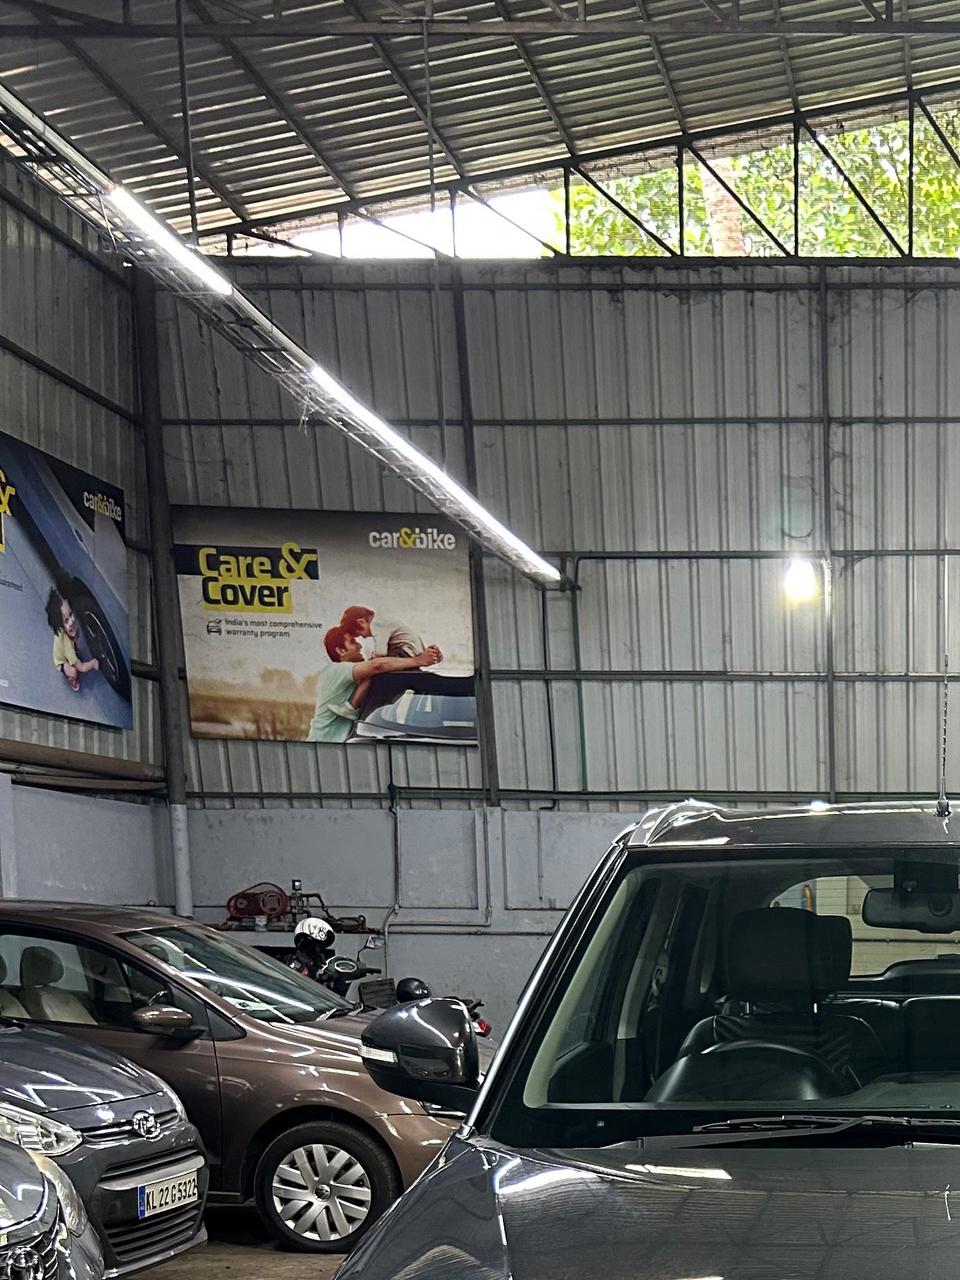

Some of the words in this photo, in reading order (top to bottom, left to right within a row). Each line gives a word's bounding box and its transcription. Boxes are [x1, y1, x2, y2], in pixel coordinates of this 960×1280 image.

[83, 490, 122, 522] car&bike
[369, 527, 457, 551] car&bike
[199, 547, 272, 578] Care
[279, 542, 318, 580] &
[202, 576, 288, 607] Cover
[225, 618, 248, 627] India's
[250, 619, 268, 627] most
[269, 620, 323, 629] comprehensive
[226, 629, 258, 638] warranty
[260, 630, 290, 638] program
[147, 1190, 157, 1211] KL
[159, 1187, 169, 1208] 22
[171, 1184, 177, 1204] G
[178, 1177, 197, 1202] 5322
